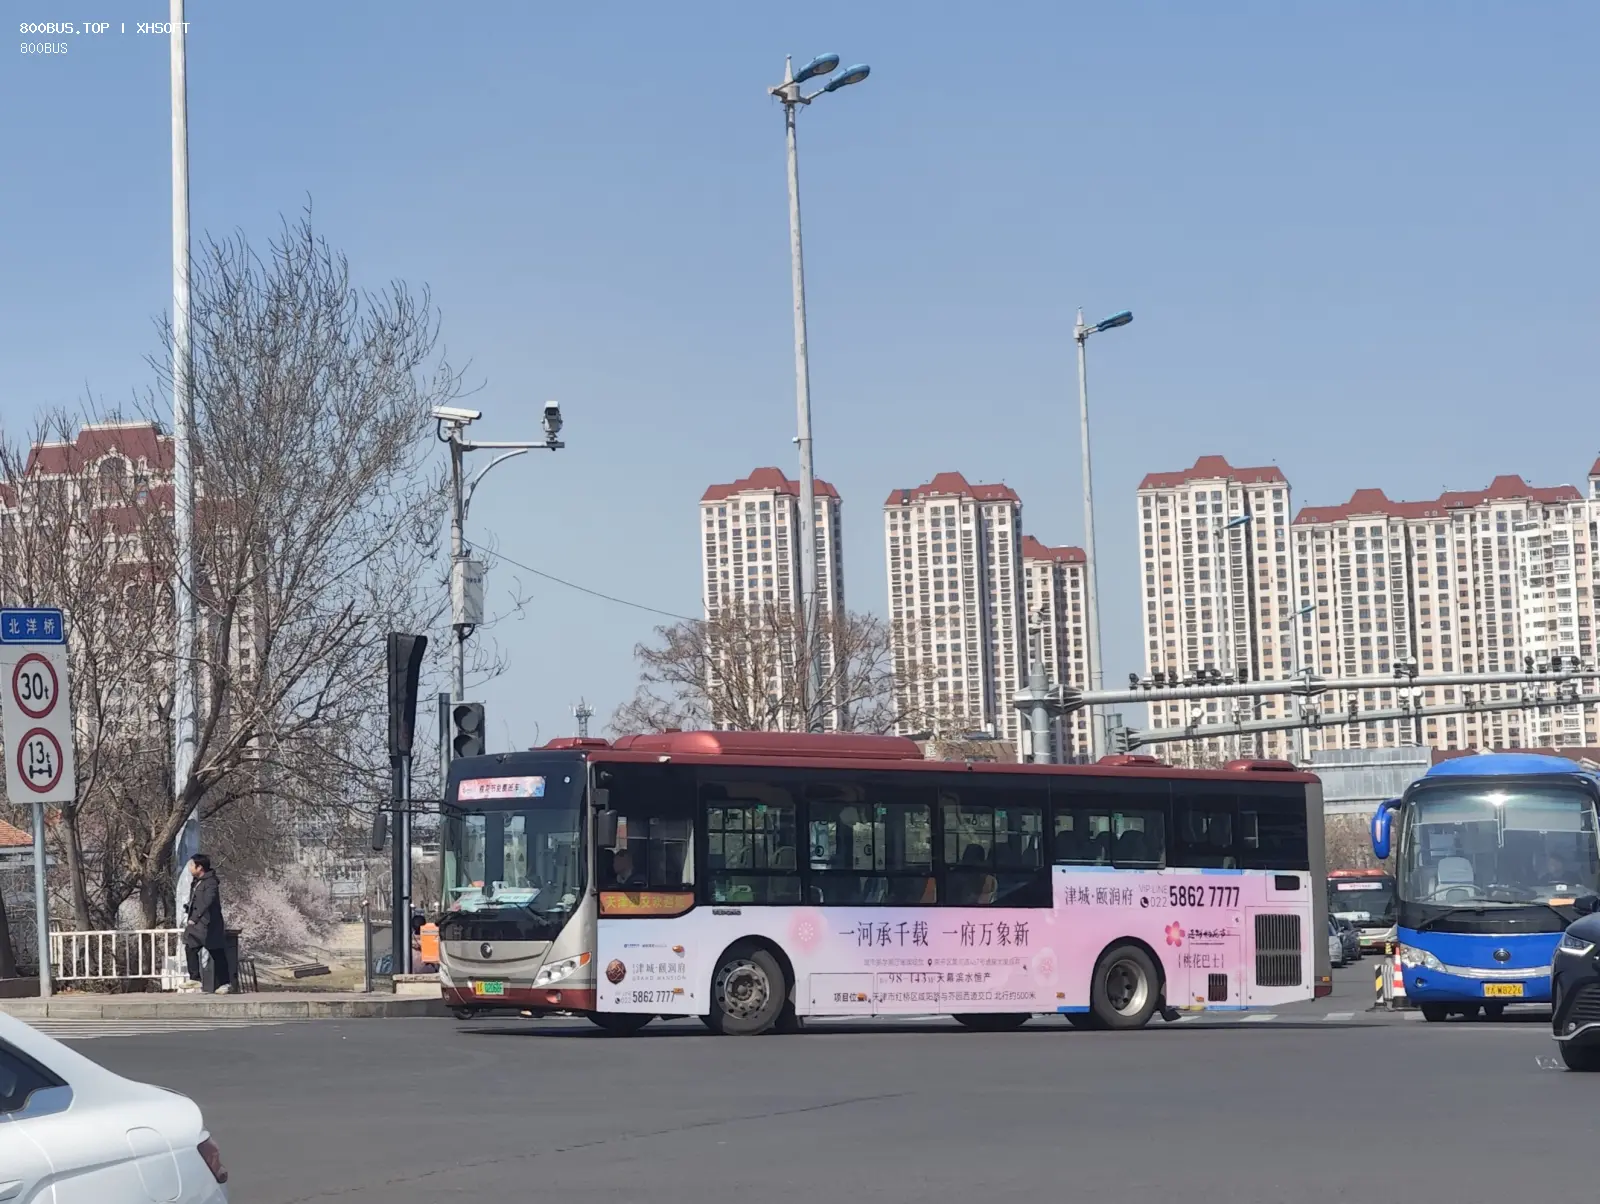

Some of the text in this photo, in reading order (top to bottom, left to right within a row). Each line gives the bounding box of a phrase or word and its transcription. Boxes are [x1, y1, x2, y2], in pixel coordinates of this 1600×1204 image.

[8, 617, 56, 635] 北洋桥
[20, 672, 50, 700] 30t
[28, 741, 52, 764] 13t
[1150, 886, 1240, 908] 022 5862 7777
[838, 920, 1030, 948] 一河承千载 一府万象新
[632, 990, 654, 1004] 5862
[655, 990, 675, 1004] 7777
